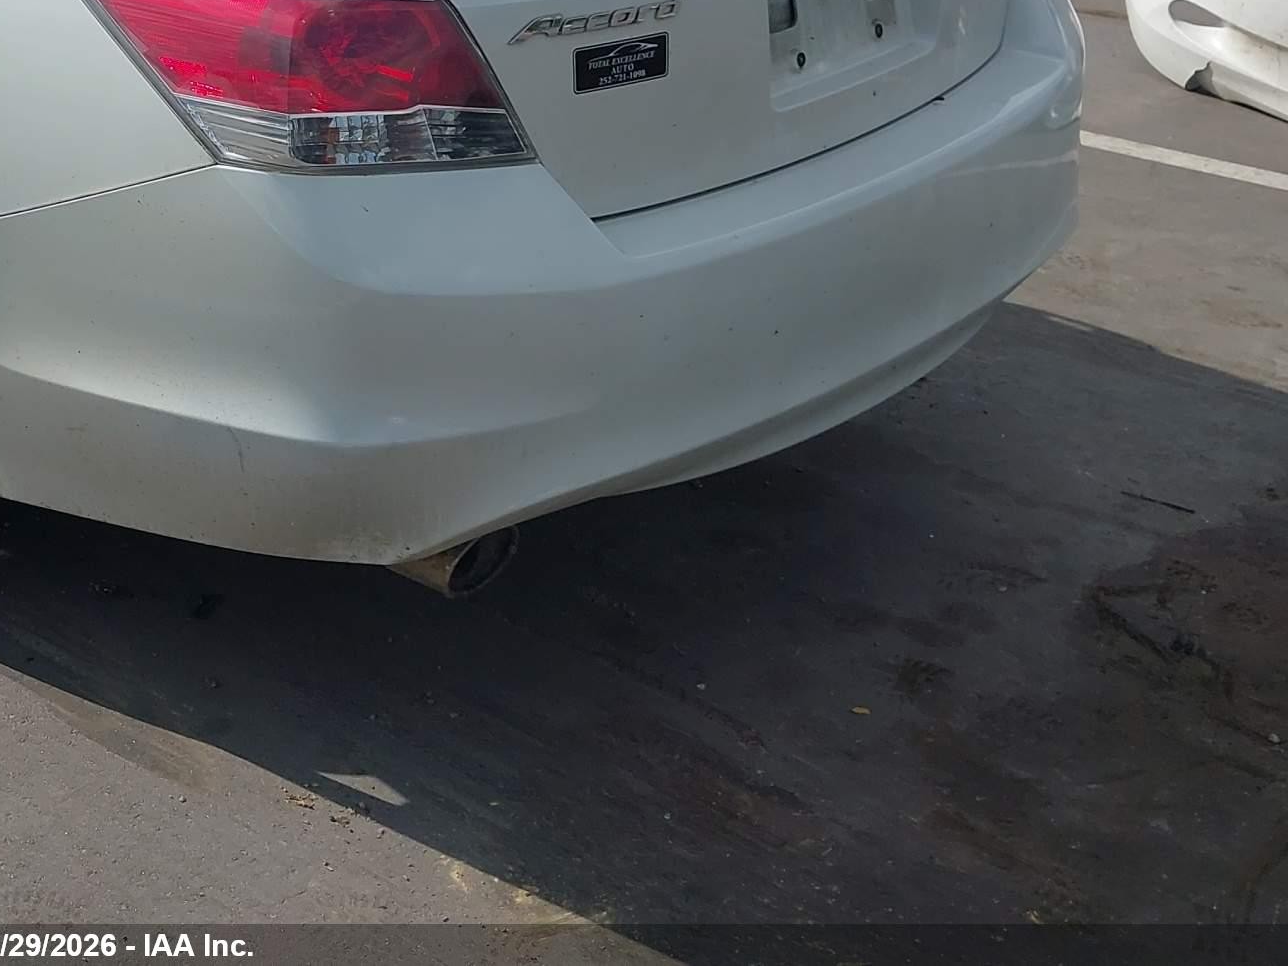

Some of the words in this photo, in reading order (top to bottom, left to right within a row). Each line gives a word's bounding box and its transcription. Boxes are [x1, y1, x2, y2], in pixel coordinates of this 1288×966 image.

[588, 59, 611, 71] TOTAL
[611, 51, 655, 65] EXCELLENCE
[611, 63, 635, 75] AUTO
